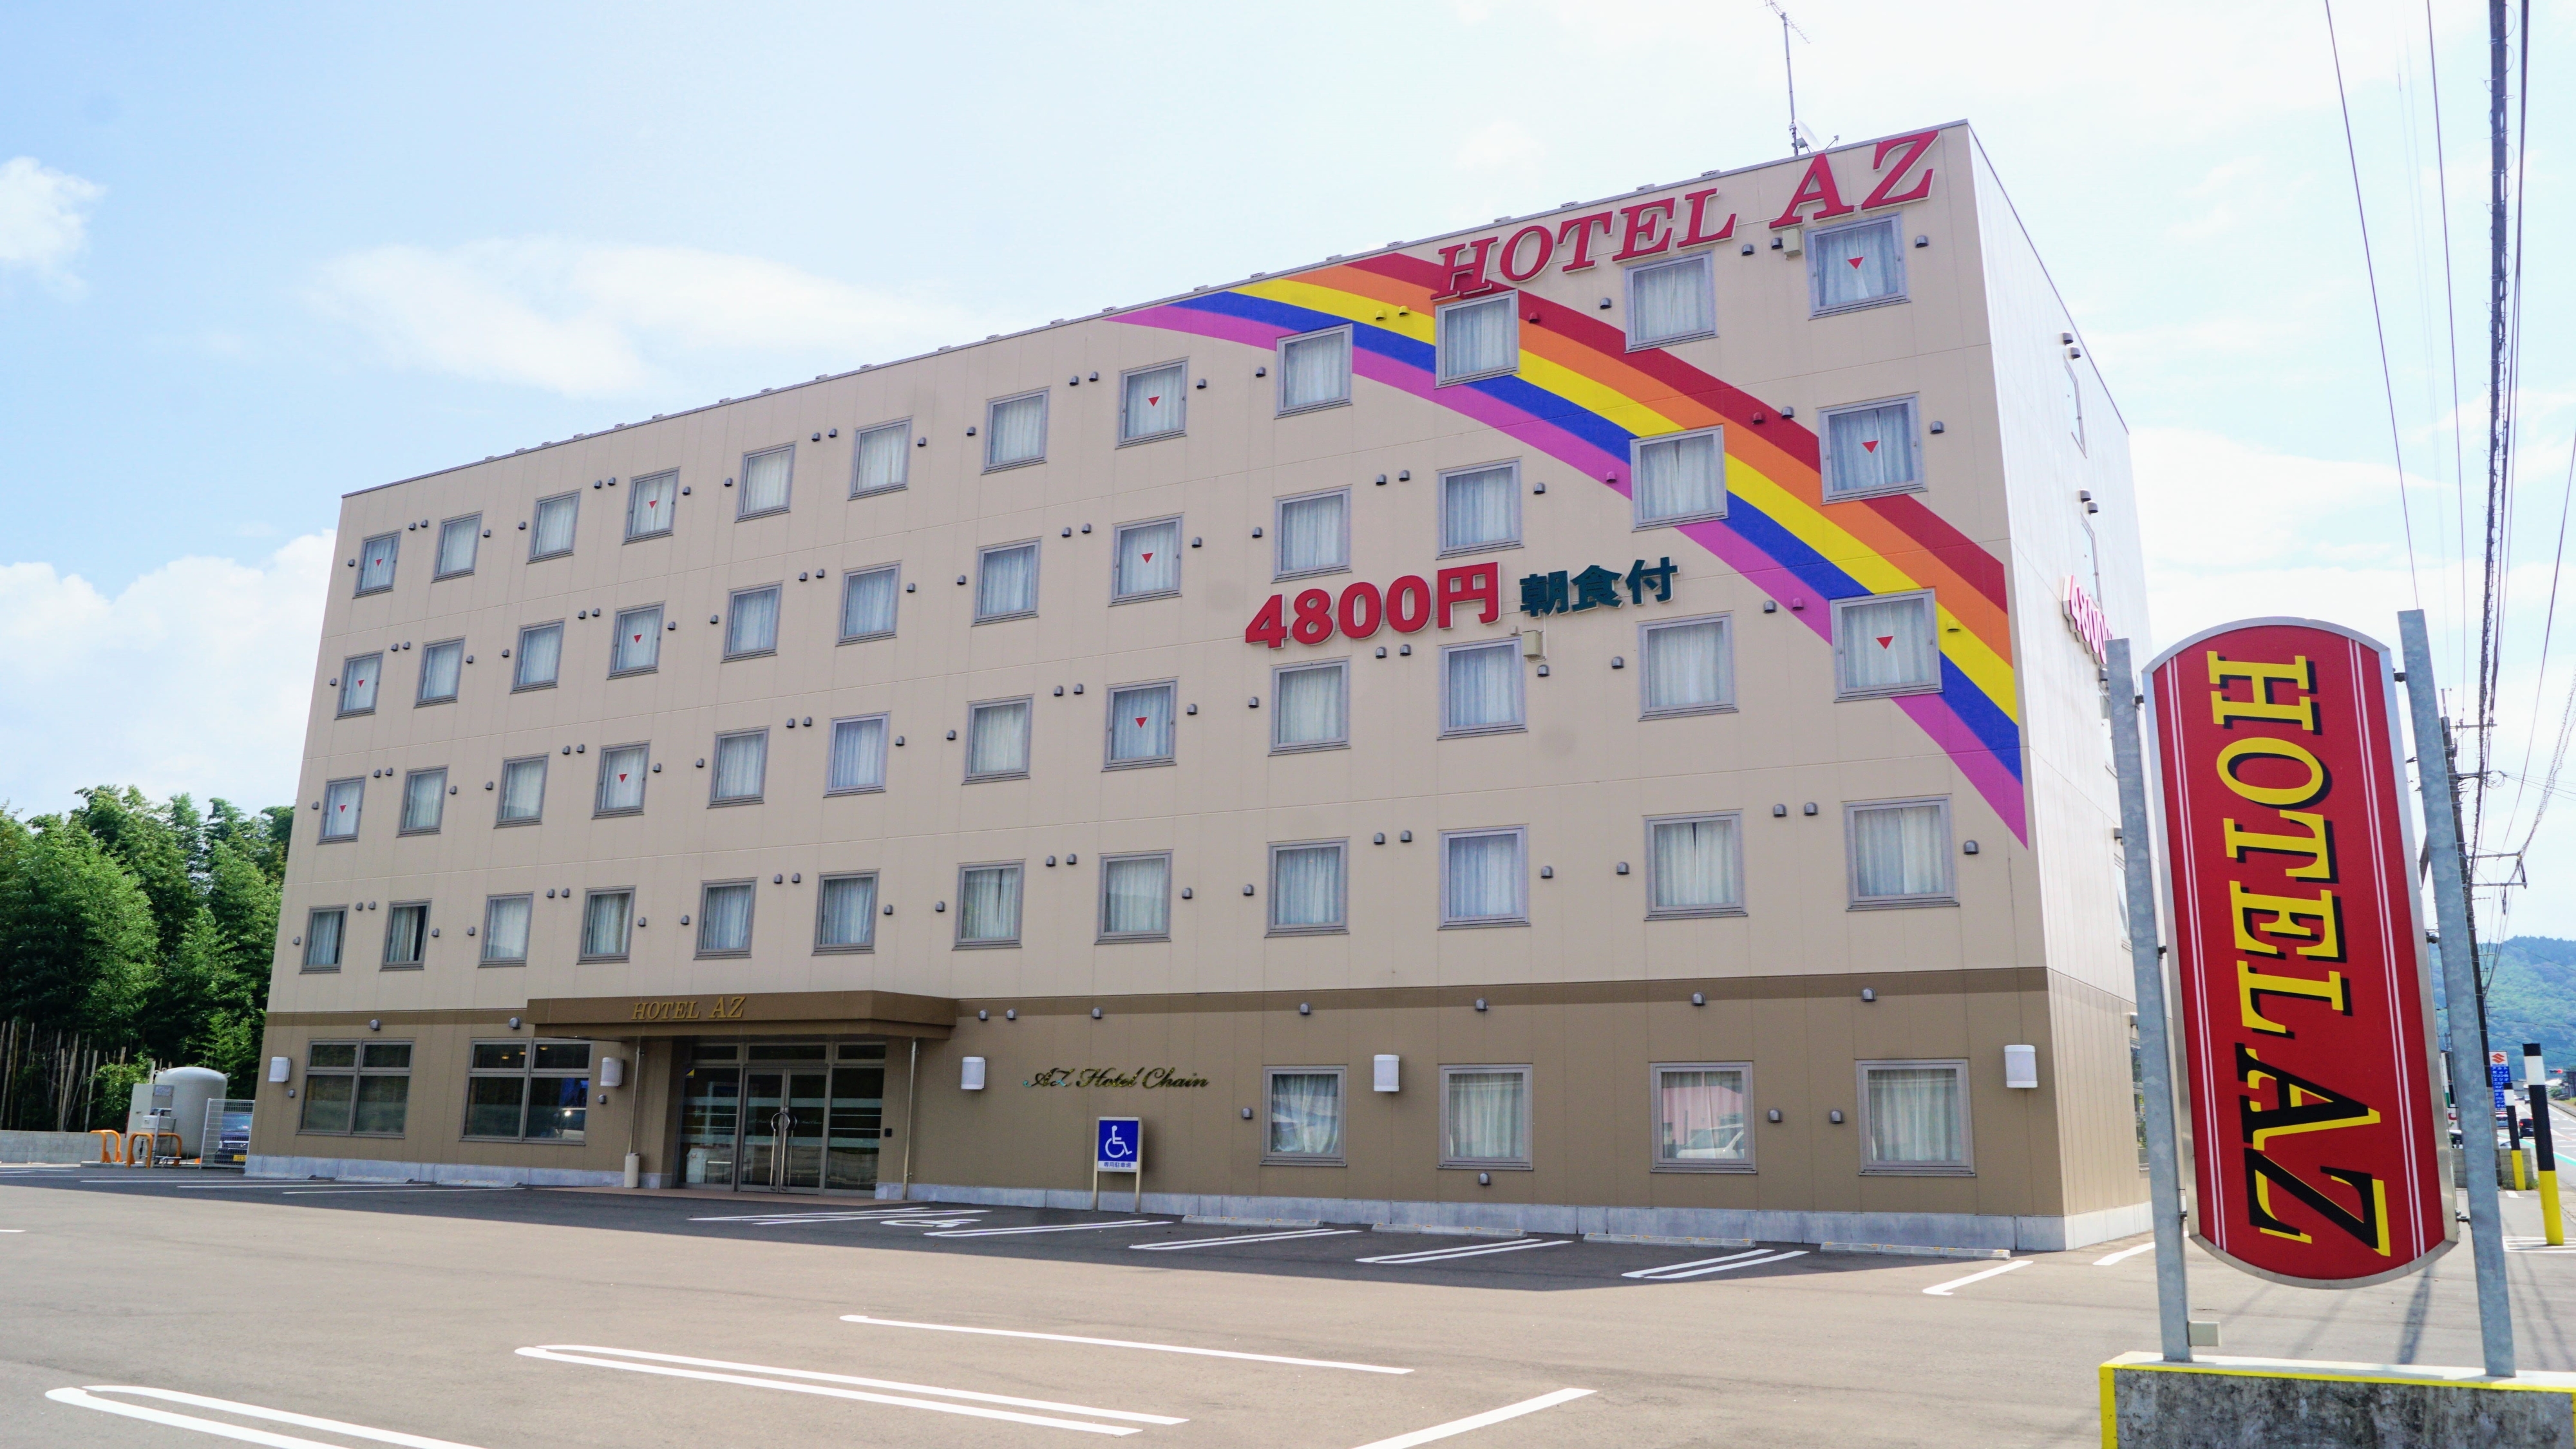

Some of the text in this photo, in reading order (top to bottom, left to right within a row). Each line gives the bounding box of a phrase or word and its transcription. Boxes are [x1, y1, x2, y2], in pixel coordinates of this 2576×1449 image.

[1430, 129, 1939, 301] HOTEL AZ
[1244, 562, 1502, 649] 4800円
[1519, 556, 1680, 618] 朝食付
[2206, 650, 2391, 1258] HOTEL AZ
[631, 996, 746, 1020] HOTEL AZ
[1075, 1066, 1145, 1088] Hotel
[1142, 1066, 1209, 1089] Chain
